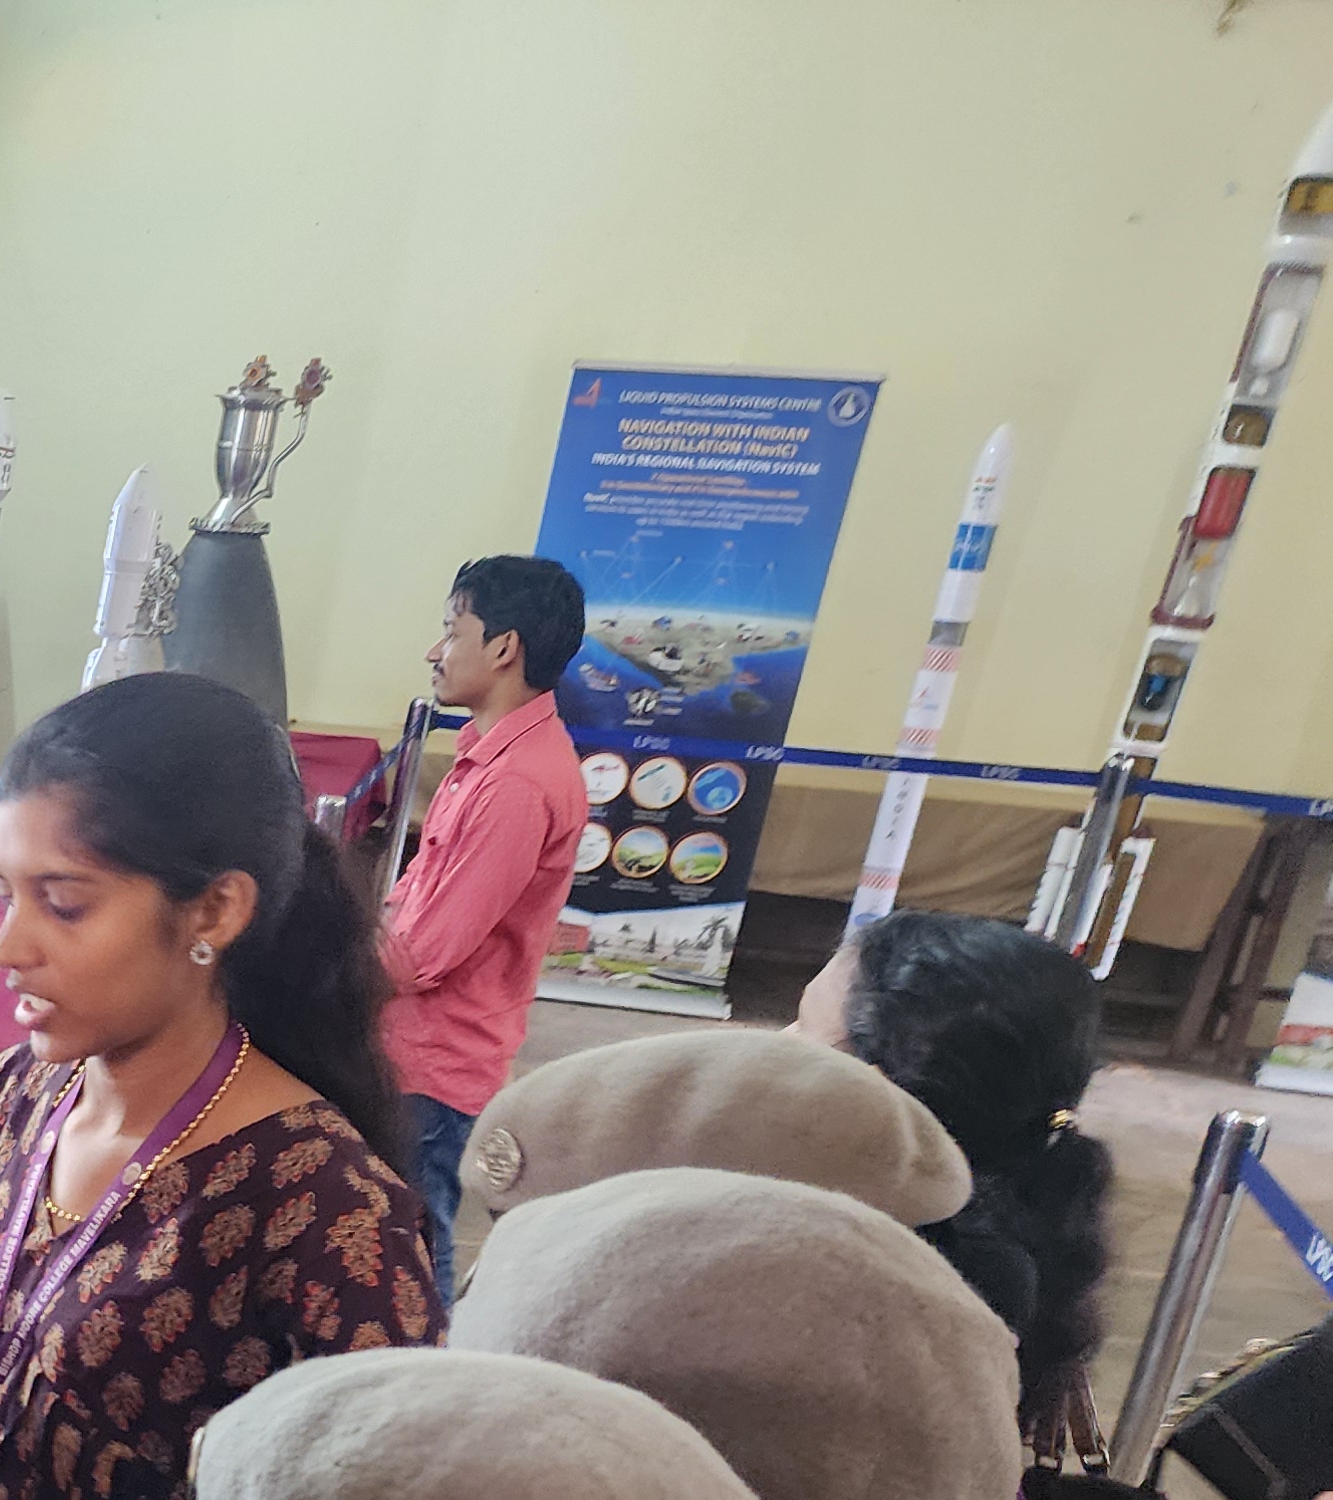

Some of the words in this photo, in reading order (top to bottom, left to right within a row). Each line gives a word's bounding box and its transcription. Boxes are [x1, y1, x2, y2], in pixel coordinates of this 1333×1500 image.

[618, 418, 710, 437] NAVIGATION
[713, 421, 753, 438] WITH
[37, 1254, 73, 1302] COLLEGE
[69, 1190, 122, 1258] MAVELIKARA
